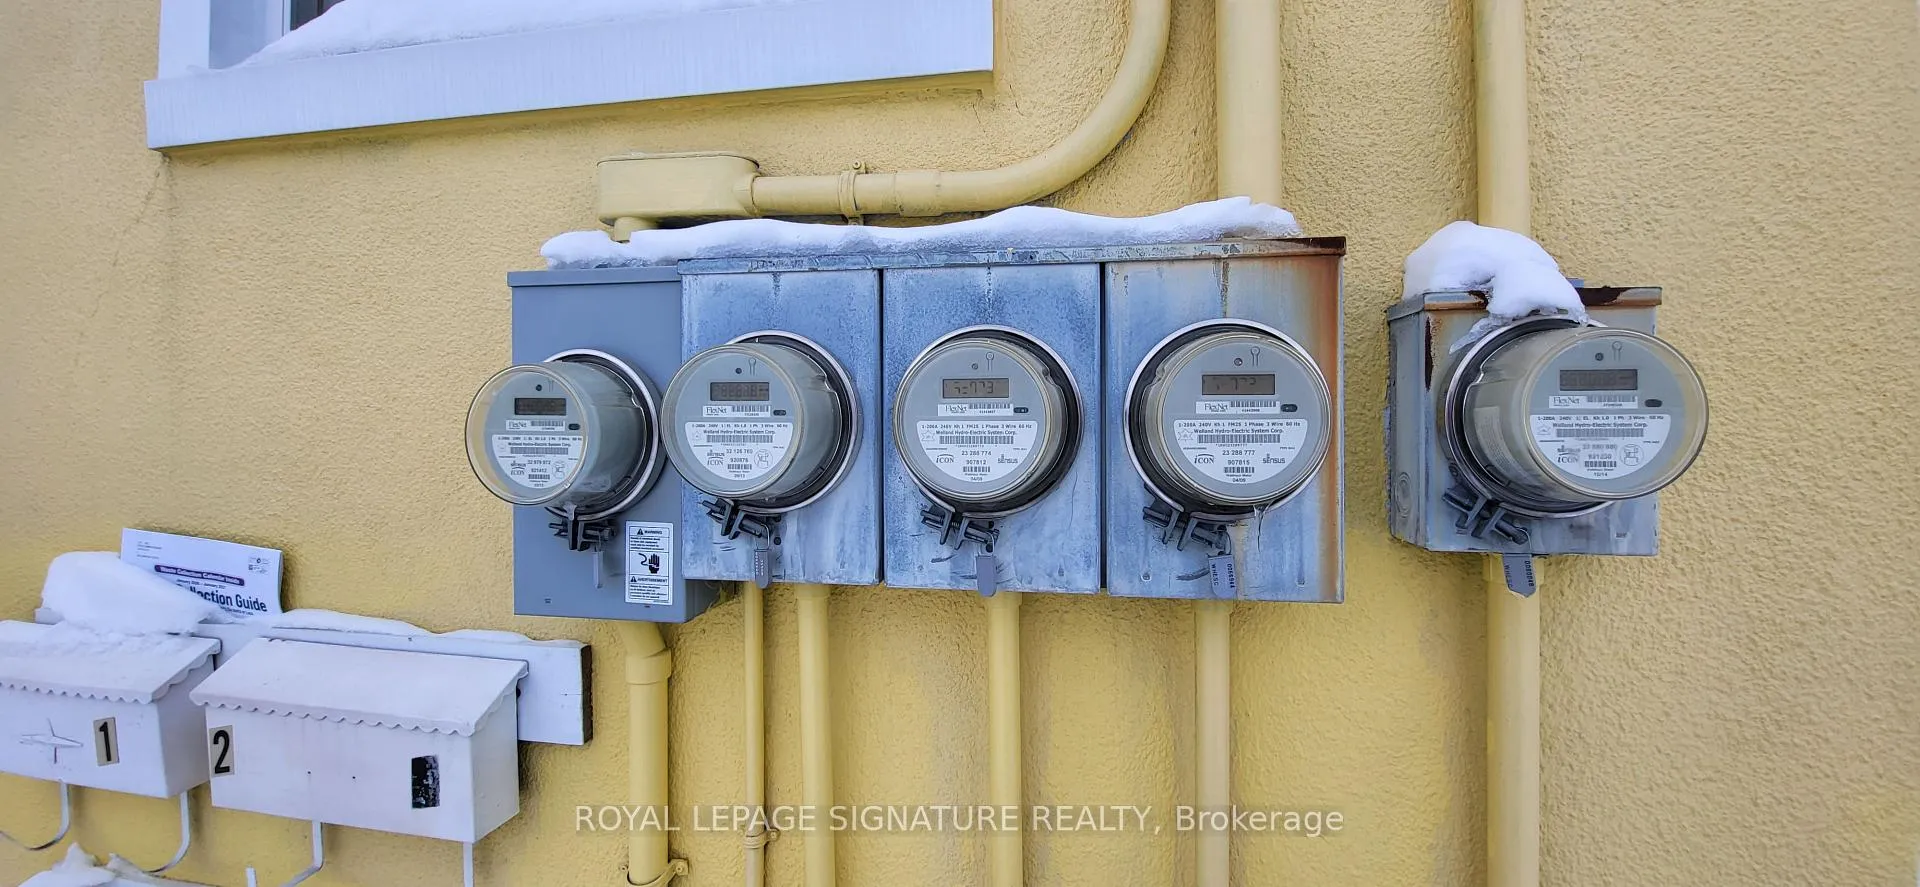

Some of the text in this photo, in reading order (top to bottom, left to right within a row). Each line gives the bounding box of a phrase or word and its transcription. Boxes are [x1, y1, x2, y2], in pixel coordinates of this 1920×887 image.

[236, 594, 268, 612] Guide
[98, 721, 112, 762] 1
[213, 730, 230, 774] 2
